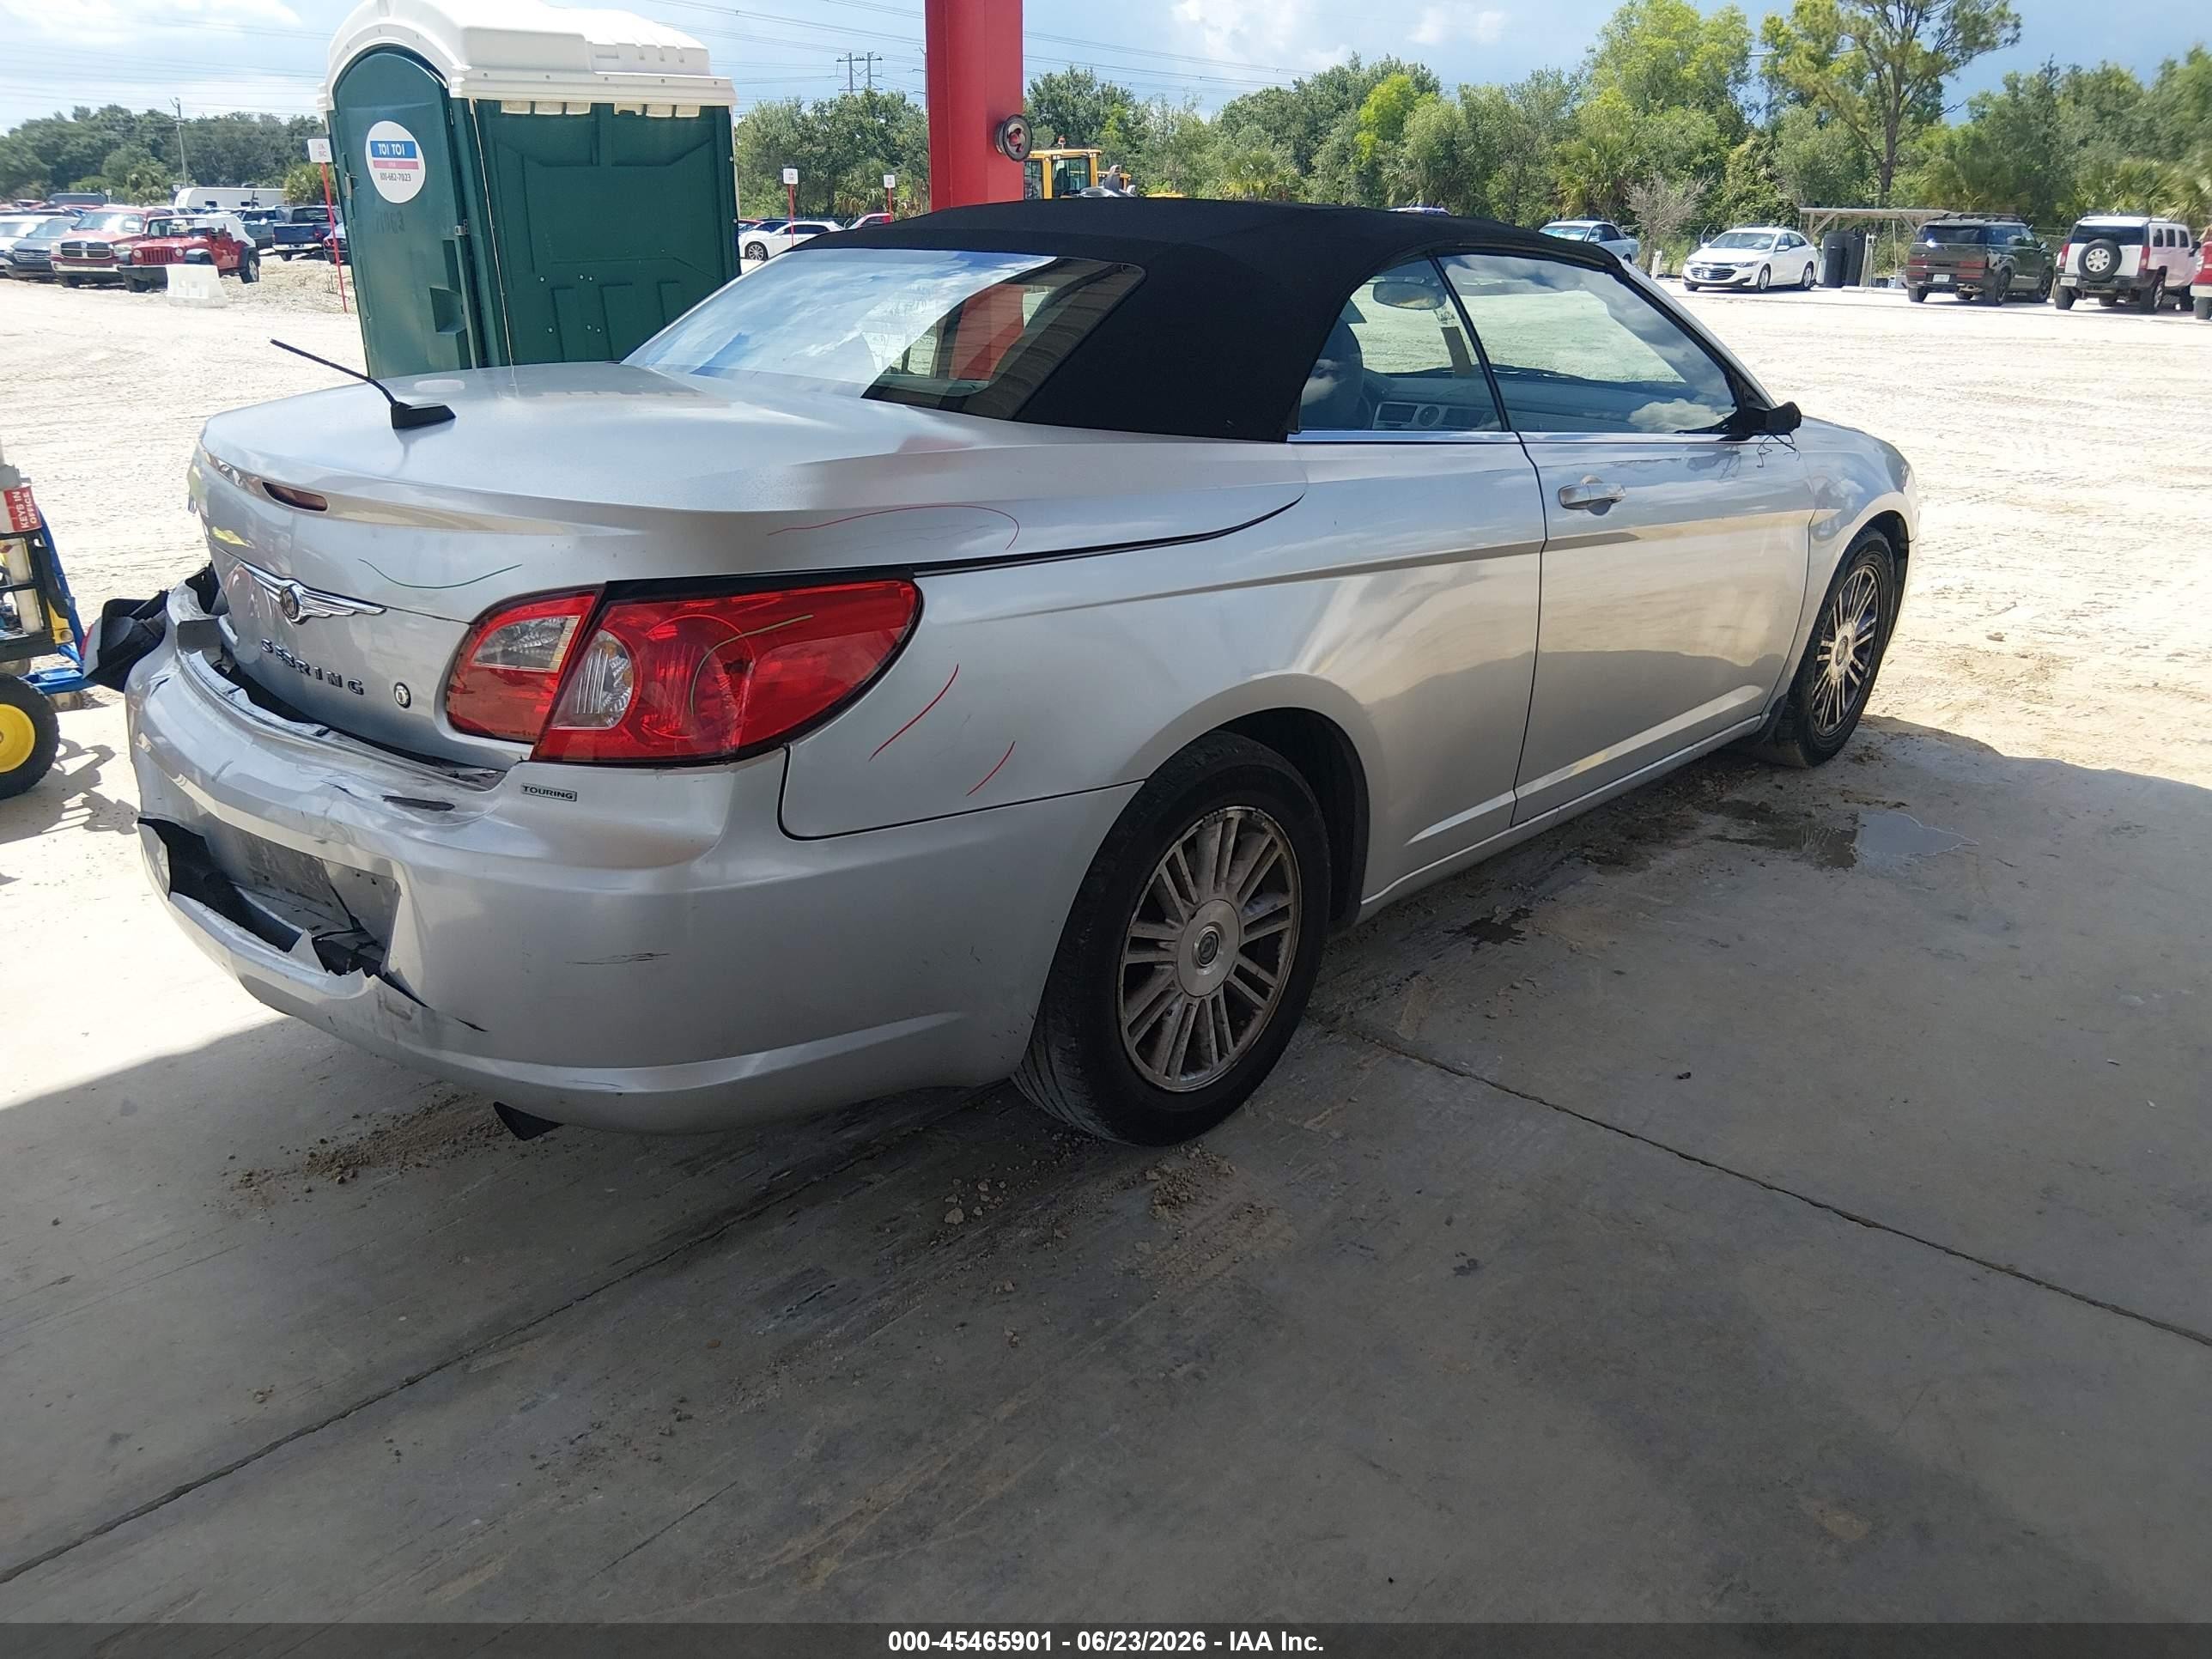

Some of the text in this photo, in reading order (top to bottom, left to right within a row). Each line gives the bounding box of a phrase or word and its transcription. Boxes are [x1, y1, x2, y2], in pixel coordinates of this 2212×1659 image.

[378, 143, 405, 155] TOI TOI
[12, 491, 30, 529] KEYS IN
[23, 491, 38, 525] OFFICE
[522, 786, 573, 799] TOURING
